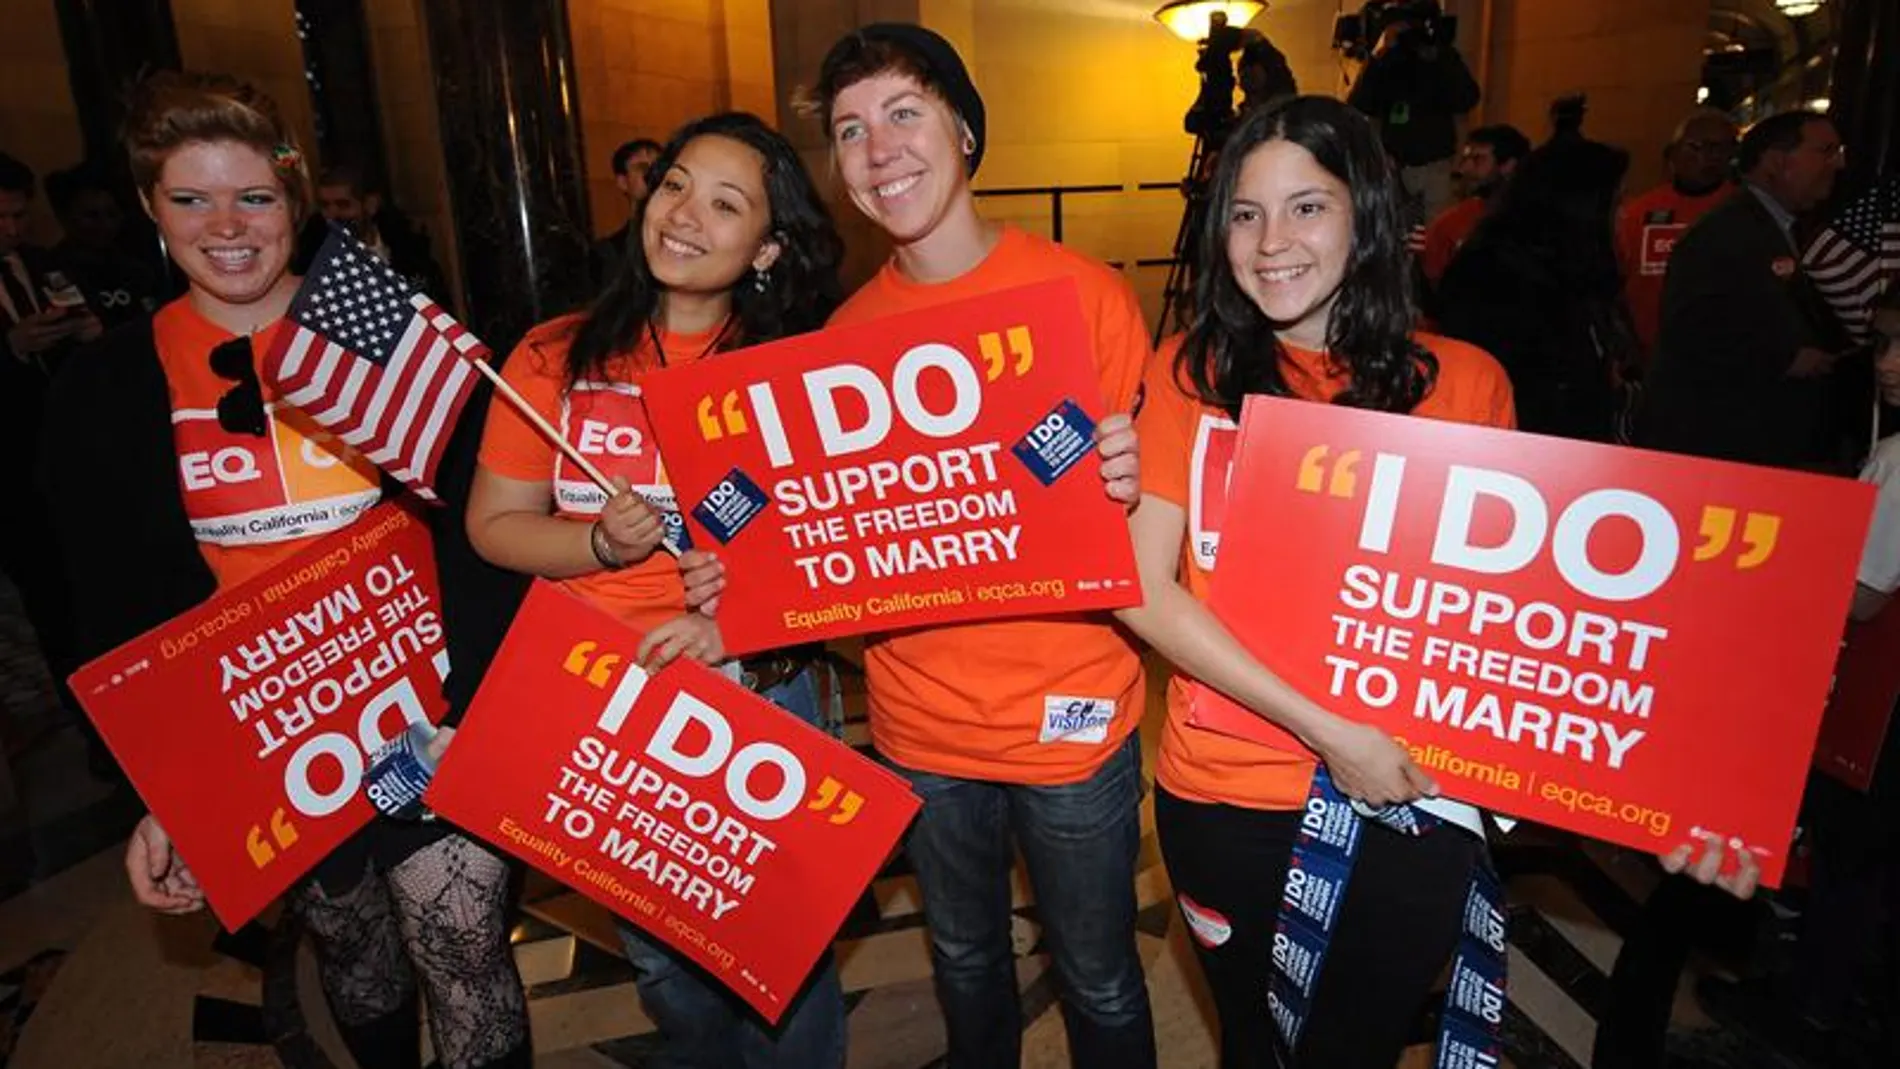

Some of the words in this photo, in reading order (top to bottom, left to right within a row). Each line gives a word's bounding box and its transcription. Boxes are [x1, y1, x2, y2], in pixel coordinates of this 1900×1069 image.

[578, 420, 643, 456] EQ
[1033, 413, 1064, 443] DO
[180, 446, 262, 492] EQ
[709, 480, 735, 507] DO
[773, 441, 1002, 518] SUPPORT
[250, 508, 329, 533] California
[782, 516, 849, 549] THE
[852, 488, 1018, 538] FREEDOM
[263, 547, 350, 602] California
[365, 554, 415, 598] TO
[794, 551, 856, 589] TO
[864, 524, 1022, 579] MARRY
[160, 604, 251, 659] eqca.org
[376, 585, 429, 629] THE
[784, 601, 862, 629] Equality
[867, 587, 964, 615] California
[976, 579, 1065, 602] eqca.org
[1339, 563, 1669, 672] SUPPORT
[219, 583, 363, 694] MARRY
[1331, 613, 1415, 662] THE
[1420, 635, 1656, 719] FREEDOM
[229, 616, 378, 722] FREEDOM
[255, 611, 443, 759] SUPPORT
[1323, 654, 1400, 709] TO
[1412, 676, 1647, 770] MARRY
[572, 737, 777, 866] SUPPORT
[1303, 797, 1327, 830] DO
[1541, 780, 1671, 836] eqca.org
[544, 792, 595, 839] TO
[599, 827, 740, 920] MARRY
[559, 766, 616, 813] THE
[615, 801, 756, 895] FREEDOM
[499, 817, 572, 867] Equality
[574, 858, 659, 914] California
[1285, 868, 1306, 899] DO
[1482, 991, 1502, 1024] DO
